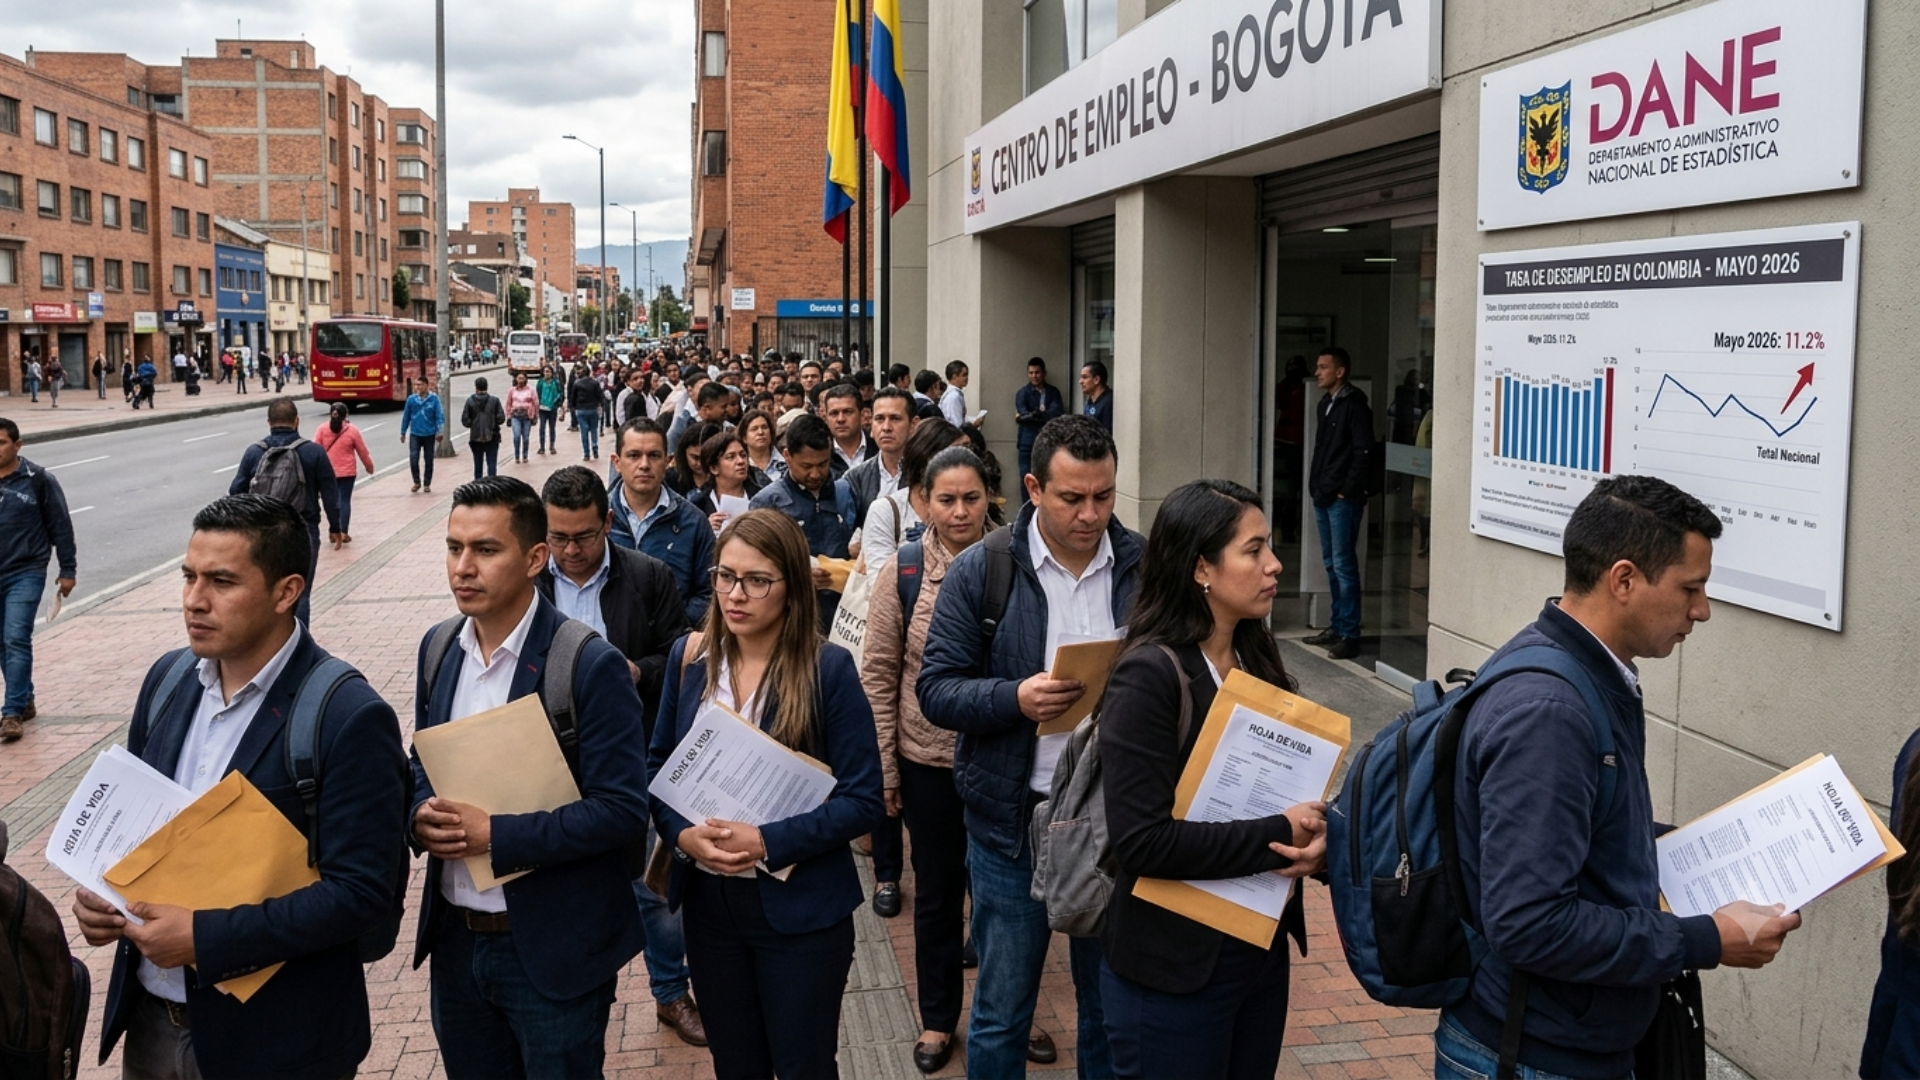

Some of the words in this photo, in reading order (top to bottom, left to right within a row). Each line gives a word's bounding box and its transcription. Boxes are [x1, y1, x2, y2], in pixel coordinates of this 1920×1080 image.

[1589, 26, 1782, 144] DANE
[991, 125, 1049, 194] CENTRO
[1055, 108, 1078, 170] DE
[1085, 57, 1179, 157] EMPLEO
[1588, 160, 1656, 185] NACIONAL
[1660, 155, 1679, 175] DE
[1683, 140, 1779, 171] ESTADÍSTICA
[1547, 265, 1612, 285] DESEMPLEO
[1614, 263, 1631, 282] EN
[1633, 258, 1702, 281] COLOMBIA
[1715, 255, 1758, 277] MAYO
[1761, 251, 1800, 275] 2026
[1714, 331, 1745, 353] Mayo
[1747, 331, 1782, 349] 2026:
[1786, 331, 1825, 350] 11.2%
